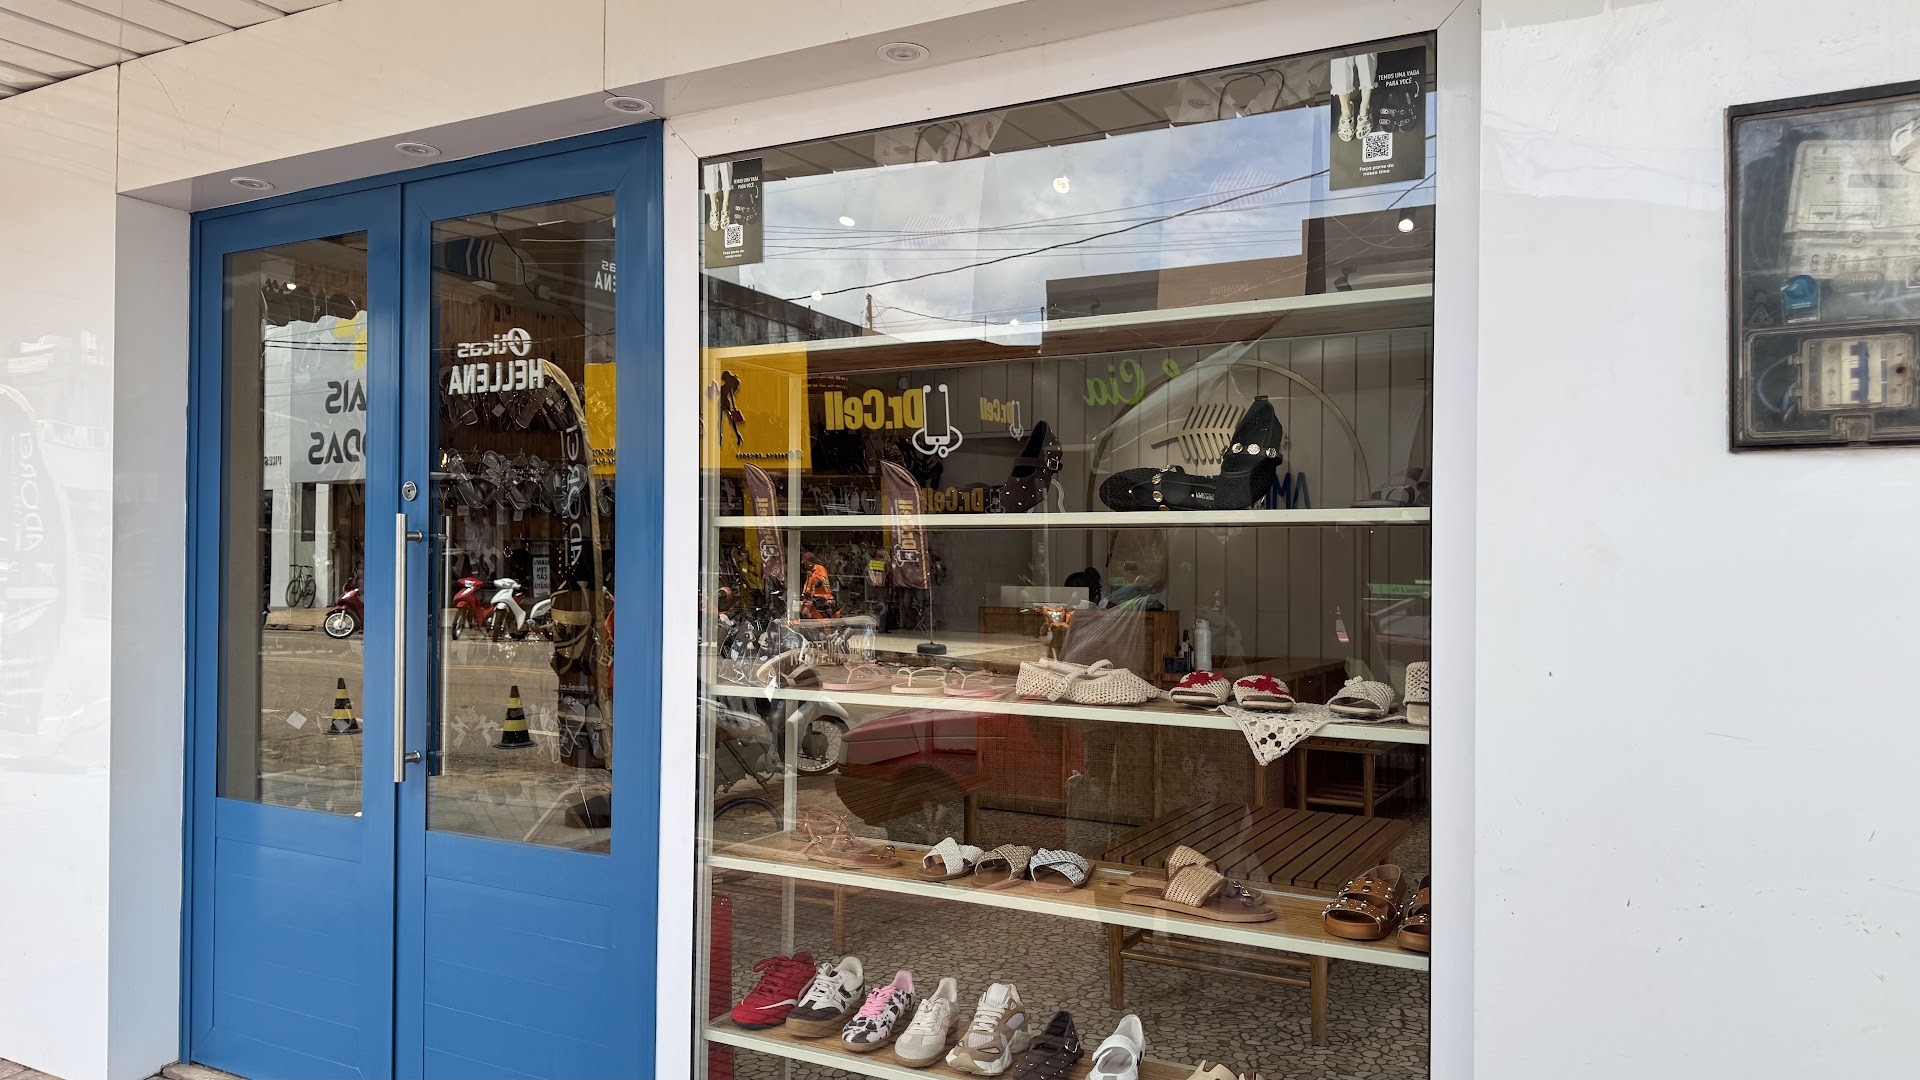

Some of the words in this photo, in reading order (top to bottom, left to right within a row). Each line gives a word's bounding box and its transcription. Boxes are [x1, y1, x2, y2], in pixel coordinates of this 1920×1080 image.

[1378, 73, 1395, 81] TEMOS
[1395, 71, 1406, 79] UMA
[1406, 69, 1420, 77] VAGA
[1385, 79, 1399, 88] PARA
[1399, 77, 1412, 85] VOCÊ
